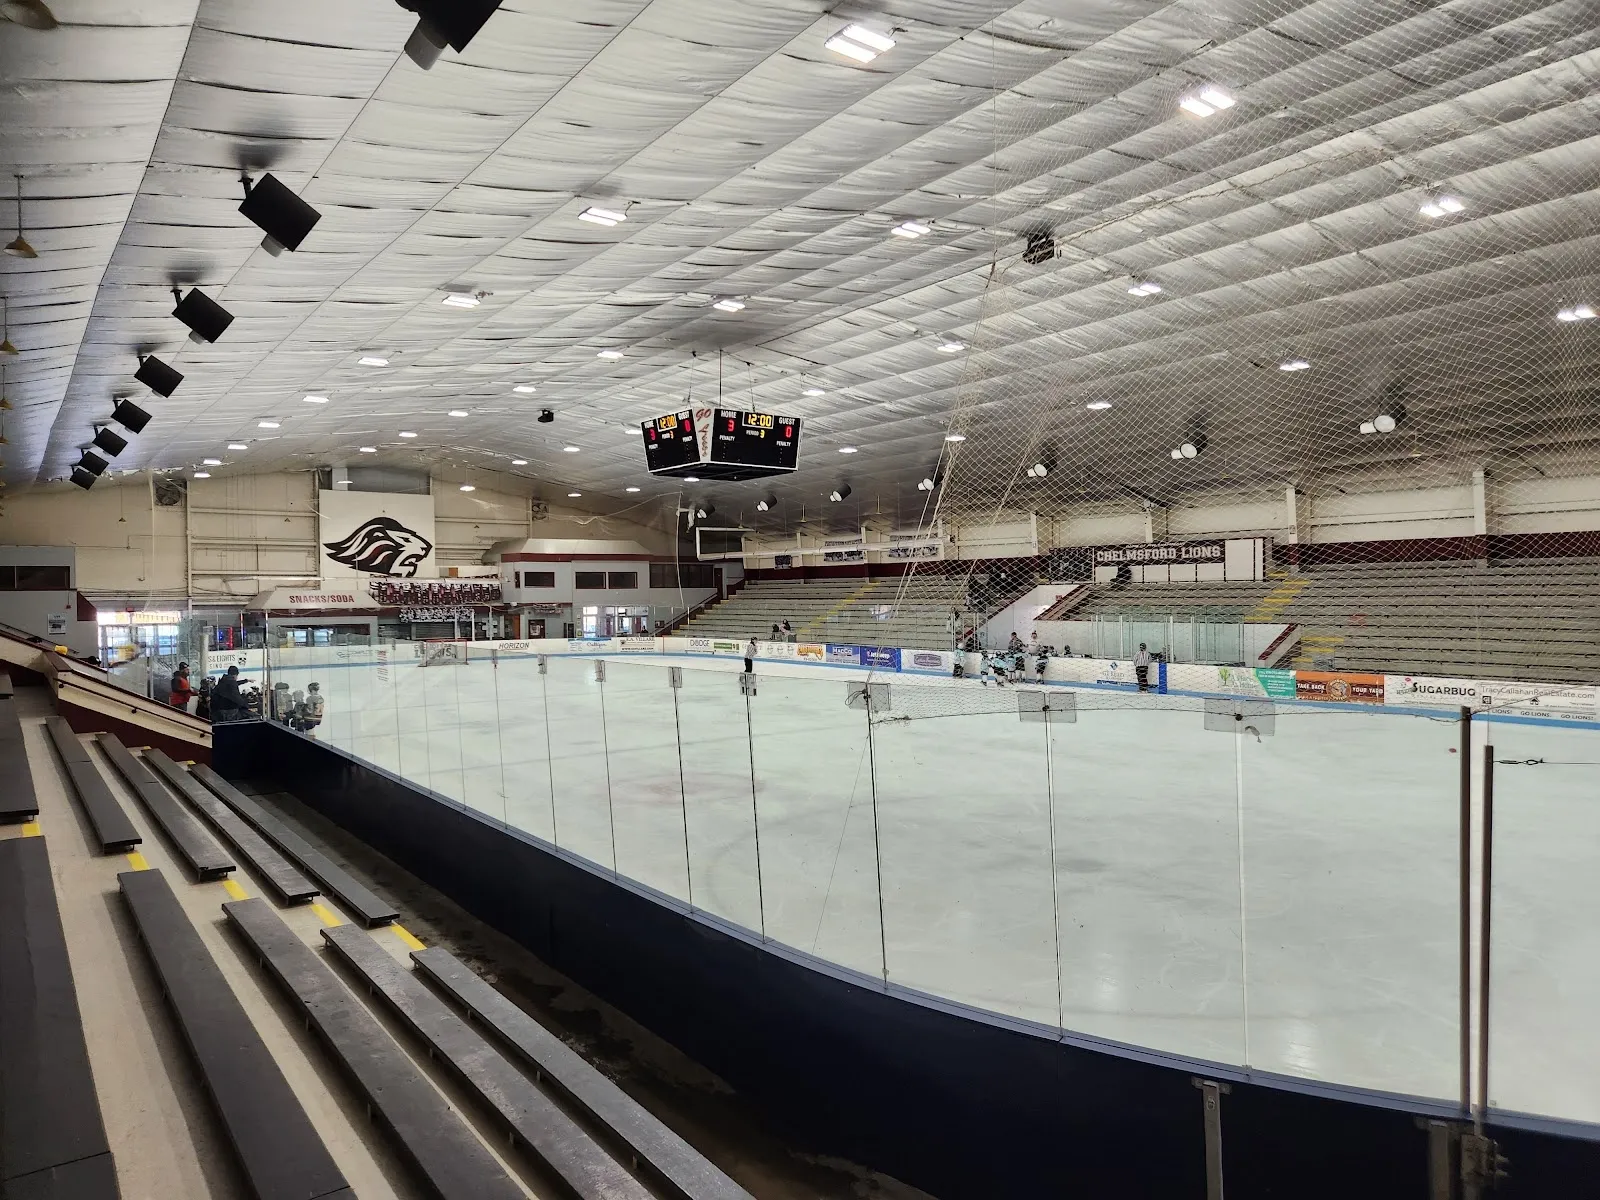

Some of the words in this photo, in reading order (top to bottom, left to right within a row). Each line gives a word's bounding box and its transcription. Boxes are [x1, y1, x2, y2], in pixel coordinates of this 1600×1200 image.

[720, 410, 737, 419] HOME
[747, 413, 772, 427] 12:00
[778, 416, 795, 426] GUEST
[660, 415, 676, 429] 12:00
[684, 419, 691, 432] 0
[727, 419, 735, 432] 3
[649, 429, 656, 440] 3
[759, 429, 766, 439] 3
[785, 425, 793, 438] 0
[1096, 548, 1177, 561] CHELMSFORD
[1181, 545, 1221, 559] LIONS
[289, 594, 355, 604] SNACKS/SODA
[1412, 682, 1476, 696] SUGARBUG
[1481, 686, 1595, 699] TracyCallahanRealEstate.com
